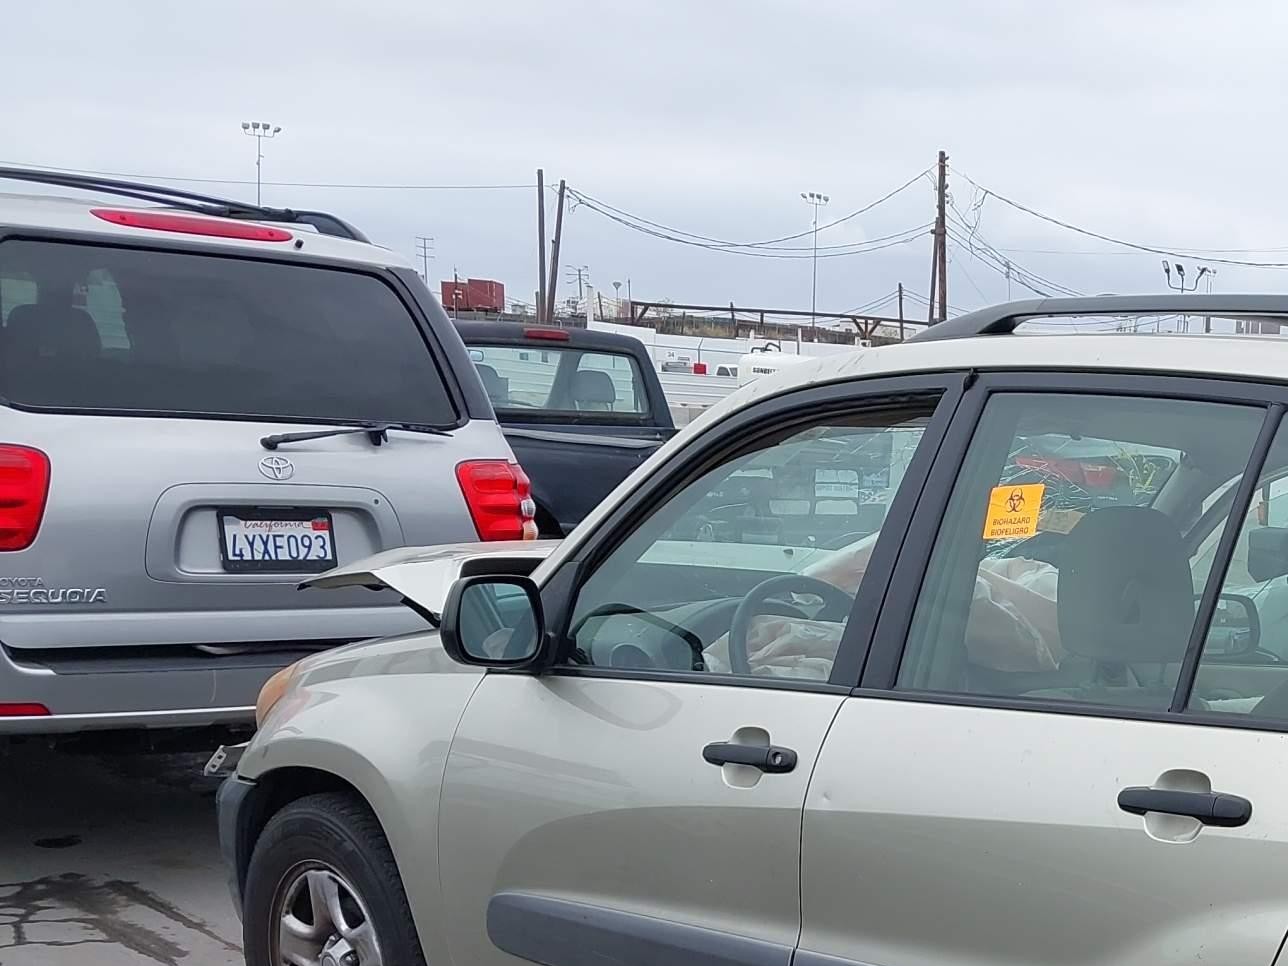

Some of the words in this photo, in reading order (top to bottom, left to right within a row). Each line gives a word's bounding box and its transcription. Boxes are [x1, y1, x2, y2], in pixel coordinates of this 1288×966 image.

[992, 516, 1031, 526] BIOHAZARD
[990, 526, 1029, 536] BIOPELIGRO
[231, 533, 328, 561] 4YXF093
[0, 577, 45, 587] OYOTA
[0, 588, 107, 604] SEQUOIA
